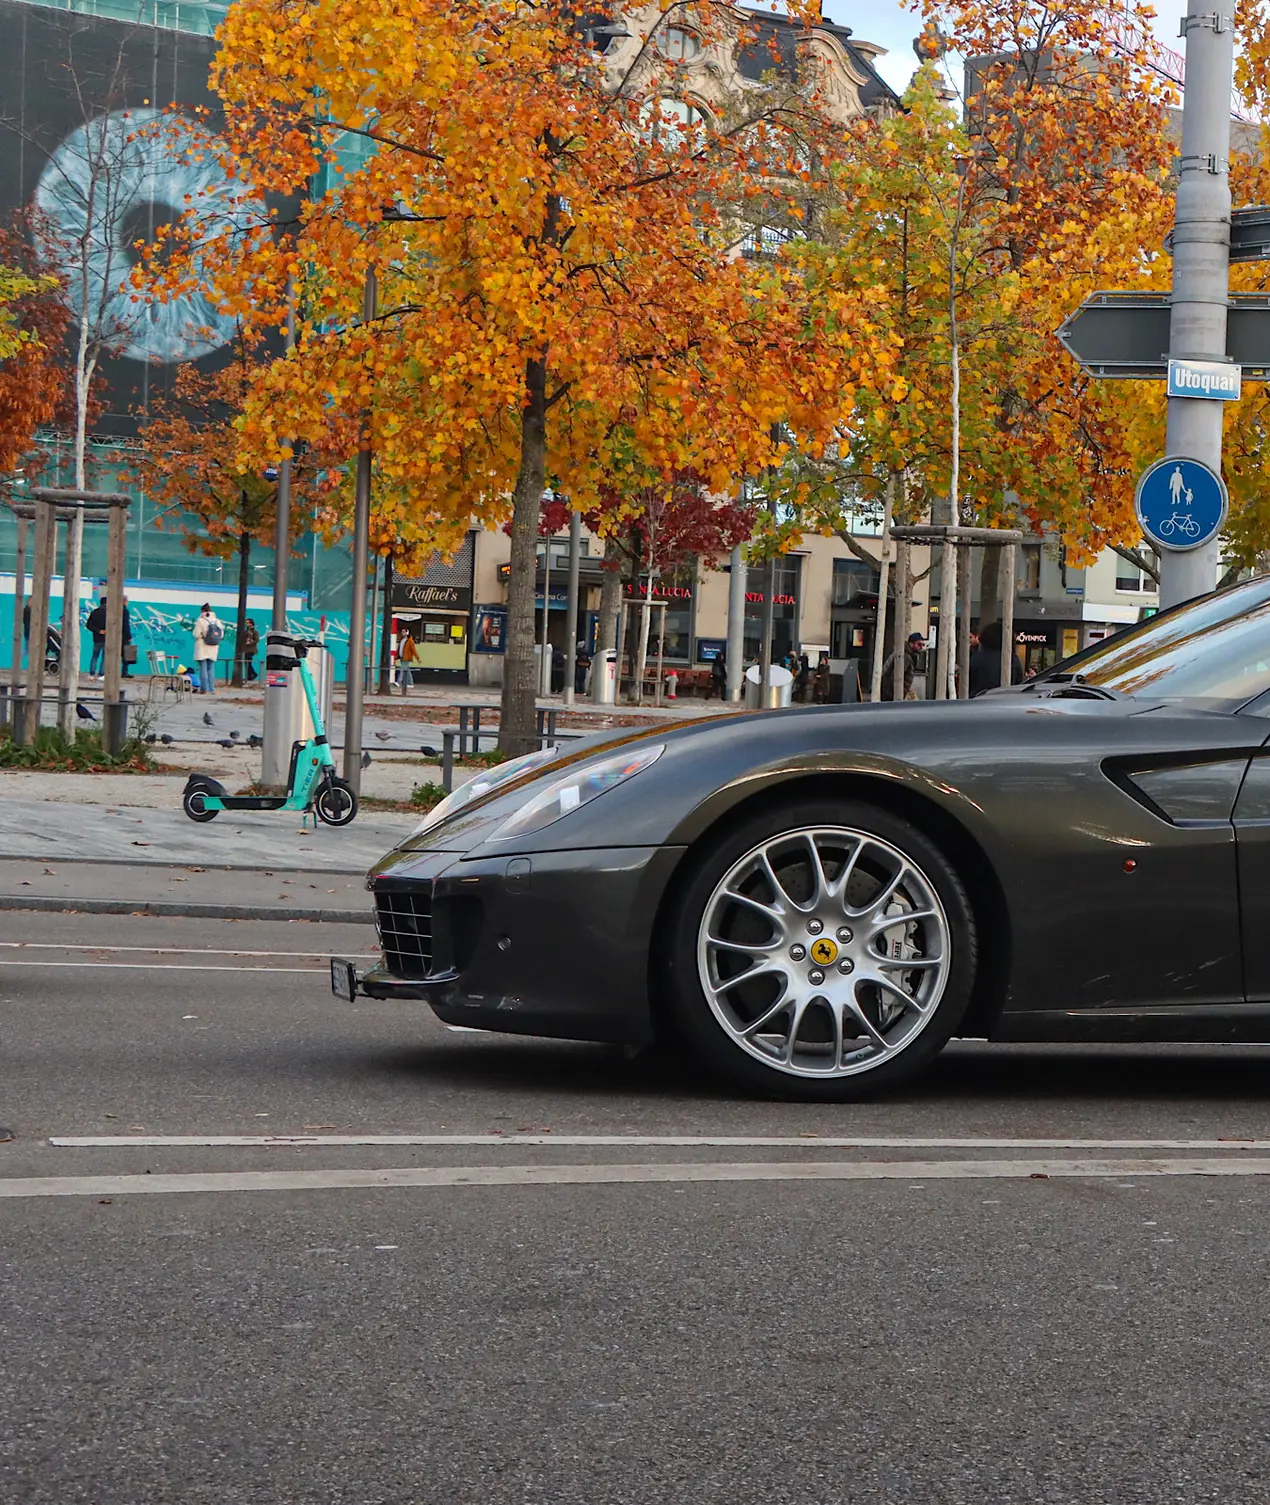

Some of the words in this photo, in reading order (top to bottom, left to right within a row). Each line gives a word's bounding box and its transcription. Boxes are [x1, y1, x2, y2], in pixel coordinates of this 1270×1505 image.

[1175, 368, 1234, 394] Utoquai
[405, 585, 458, 603] Raffael's
[662, 586, 691, 598] LUCIA
[745, 592, 764, 603] NTA
[772, 594, 796, 605] UCIA
[301, 767, 315, 793] TIER
